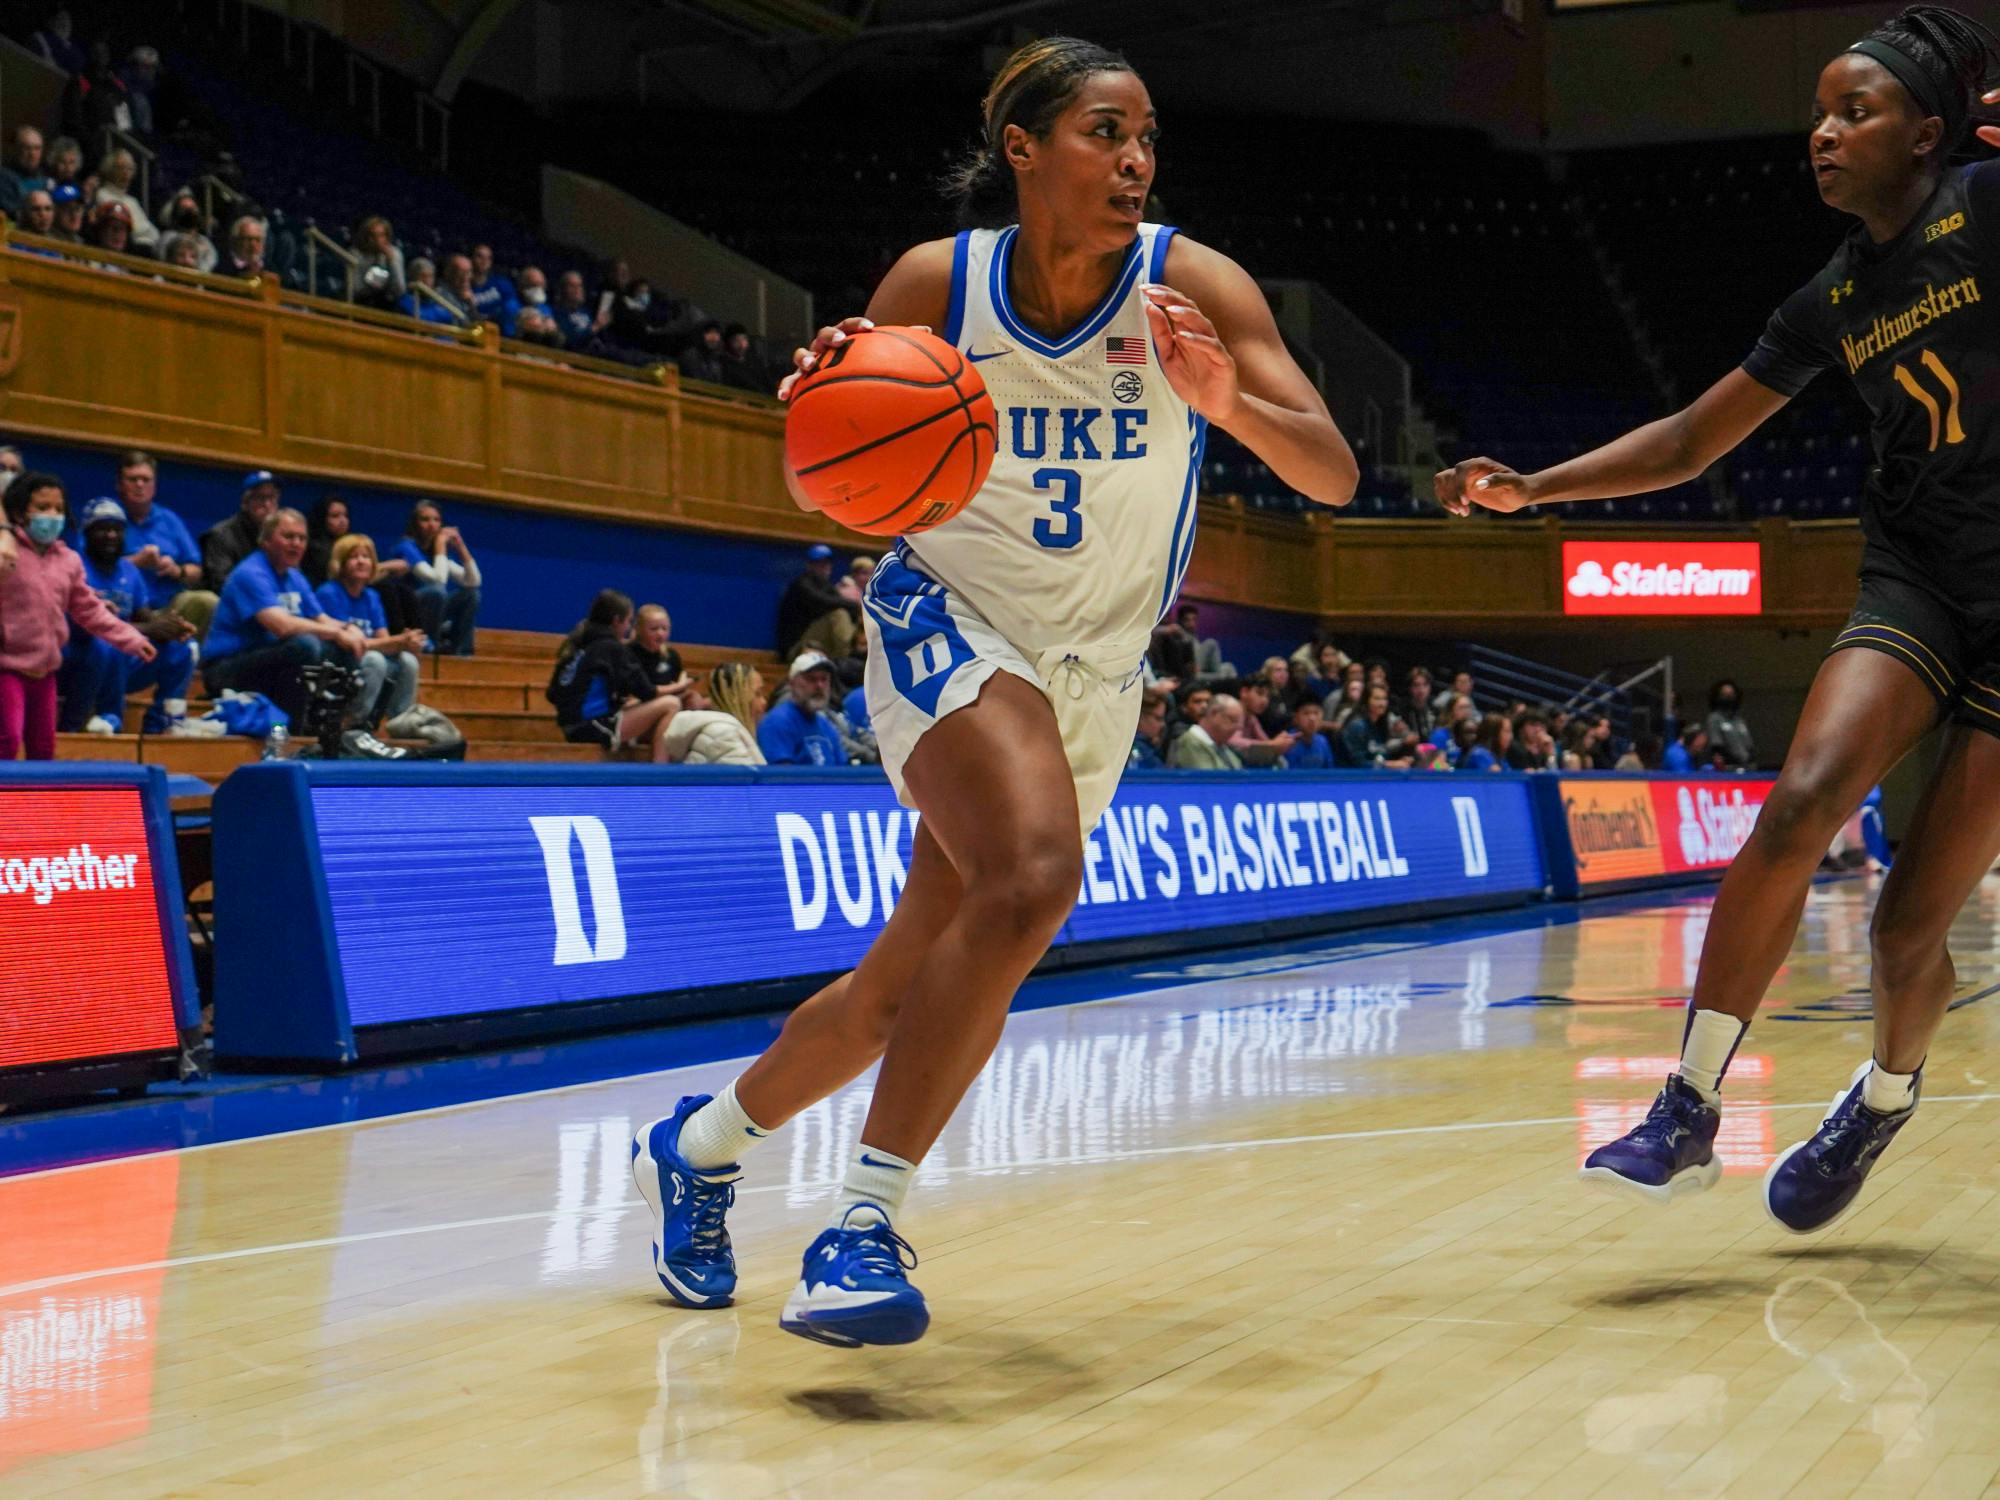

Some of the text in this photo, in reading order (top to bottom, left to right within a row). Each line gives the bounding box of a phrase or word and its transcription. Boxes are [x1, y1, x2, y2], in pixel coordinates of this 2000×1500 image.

[1840, 275, 1982, 376] Northwestern
[994, 407, 1148, 460] UKE
[1893, 348, 1967, 452] 11
[1032, 467, 1083, 549] 3
[775, 799, 1410, 931] DUK EN'S BASKETBALL
[1450, 796, 1489, 878] D
[528, 815, 627, 966] D
